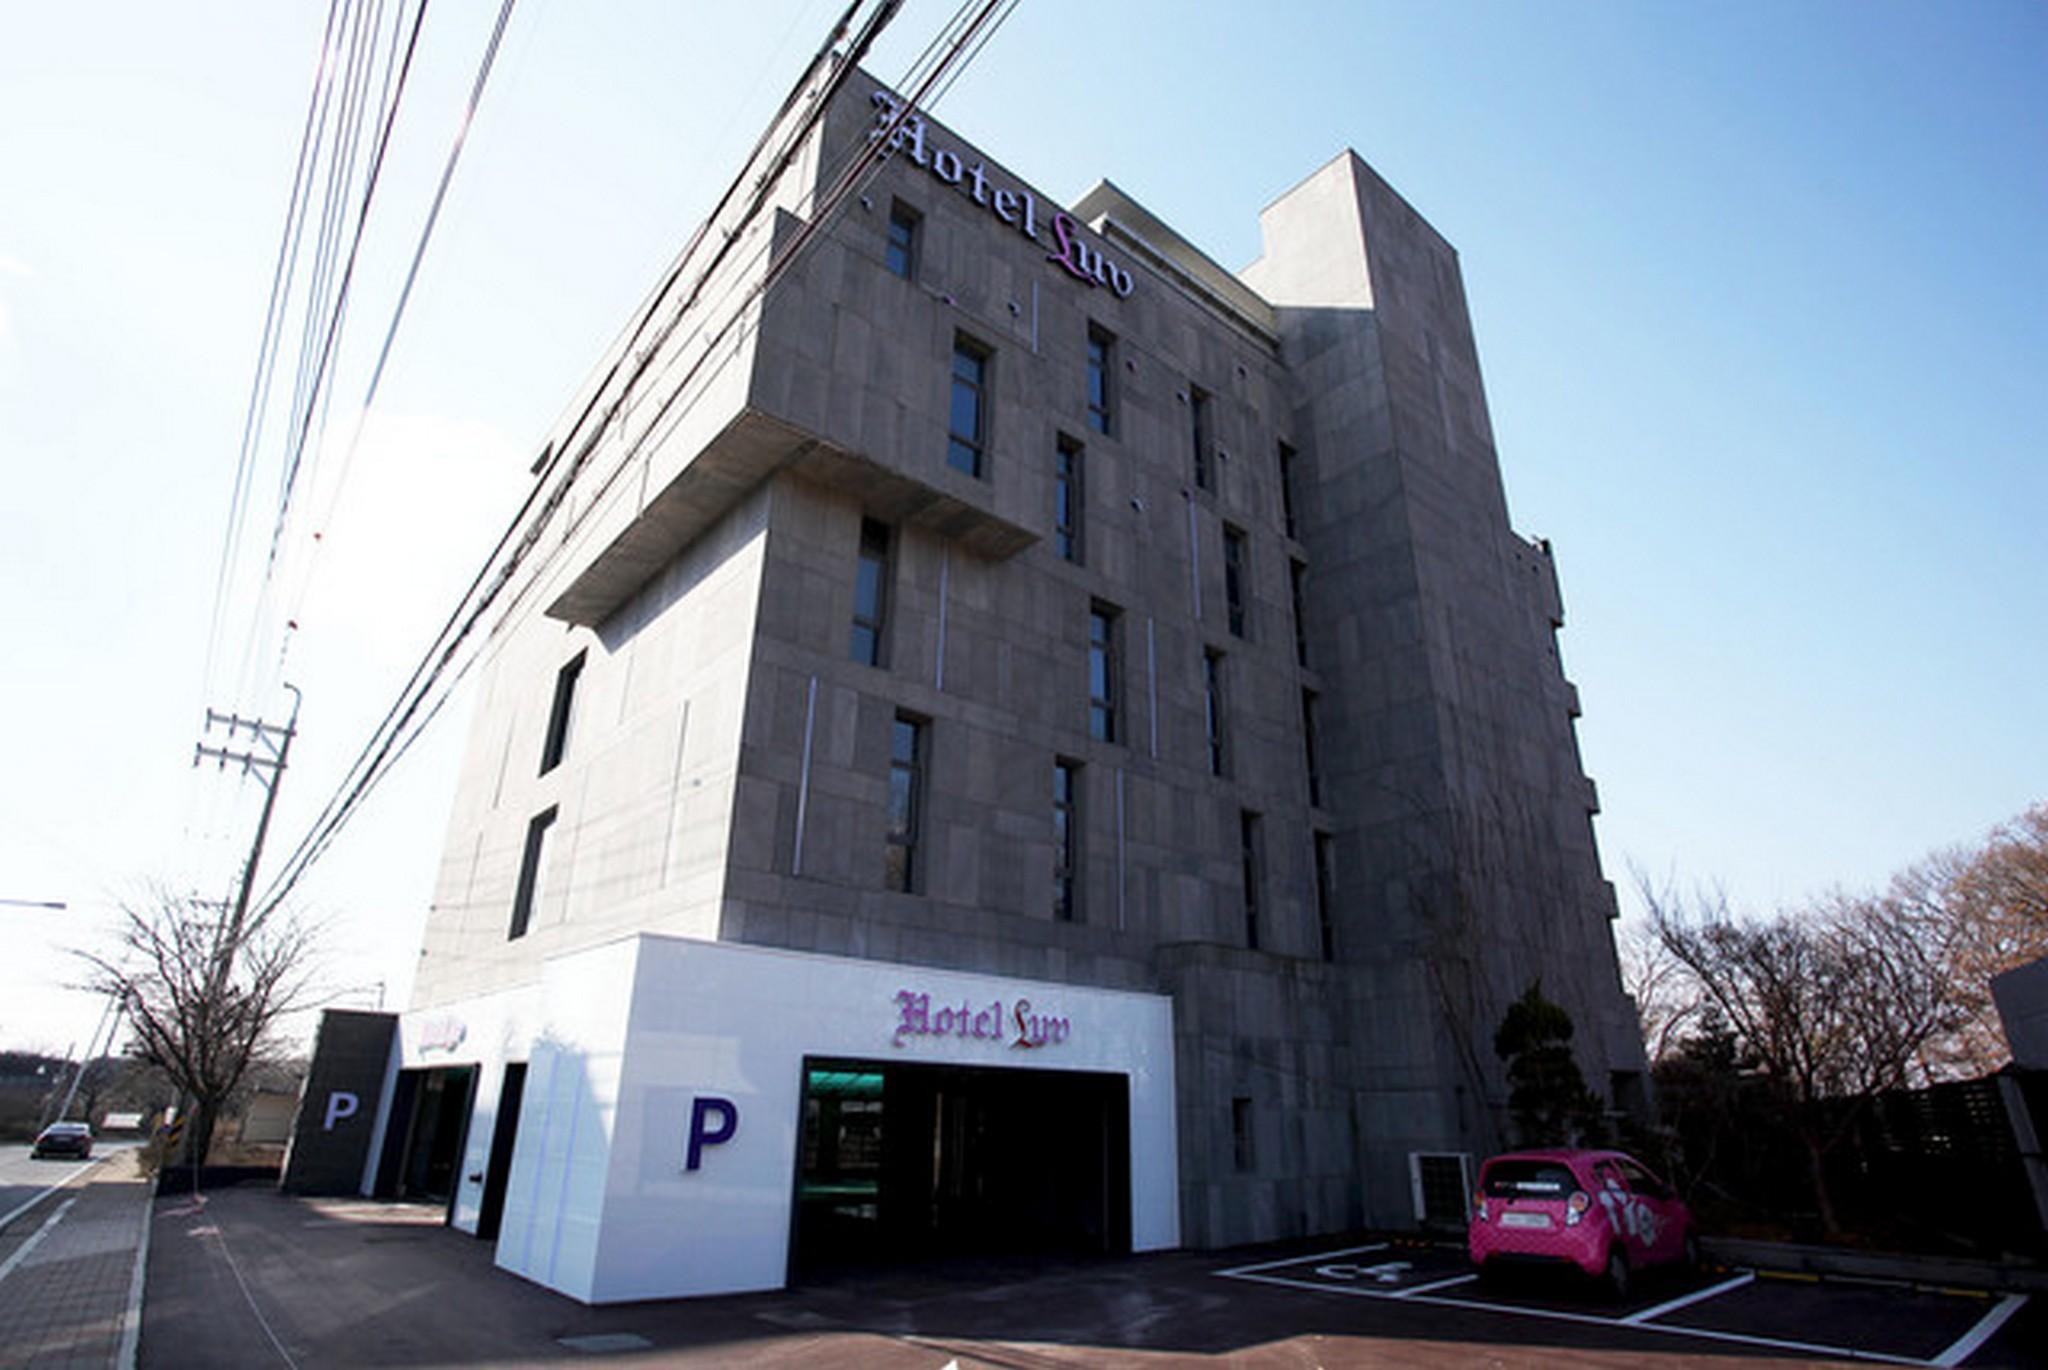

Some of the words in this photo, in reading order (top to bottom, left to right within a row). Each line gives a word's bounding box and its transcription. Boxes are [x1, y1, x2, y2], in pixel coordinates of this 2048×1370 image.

[869, 90, 1039, 240] Hotel
[1046, 211, 1134, 298] Luv
[894, 989, 1003, 1048] Hotel
[1009, 998, 1071, 1050] Luv
[323, 1091, 360, 1131] P
[684, 1096, 739, 1172] P
